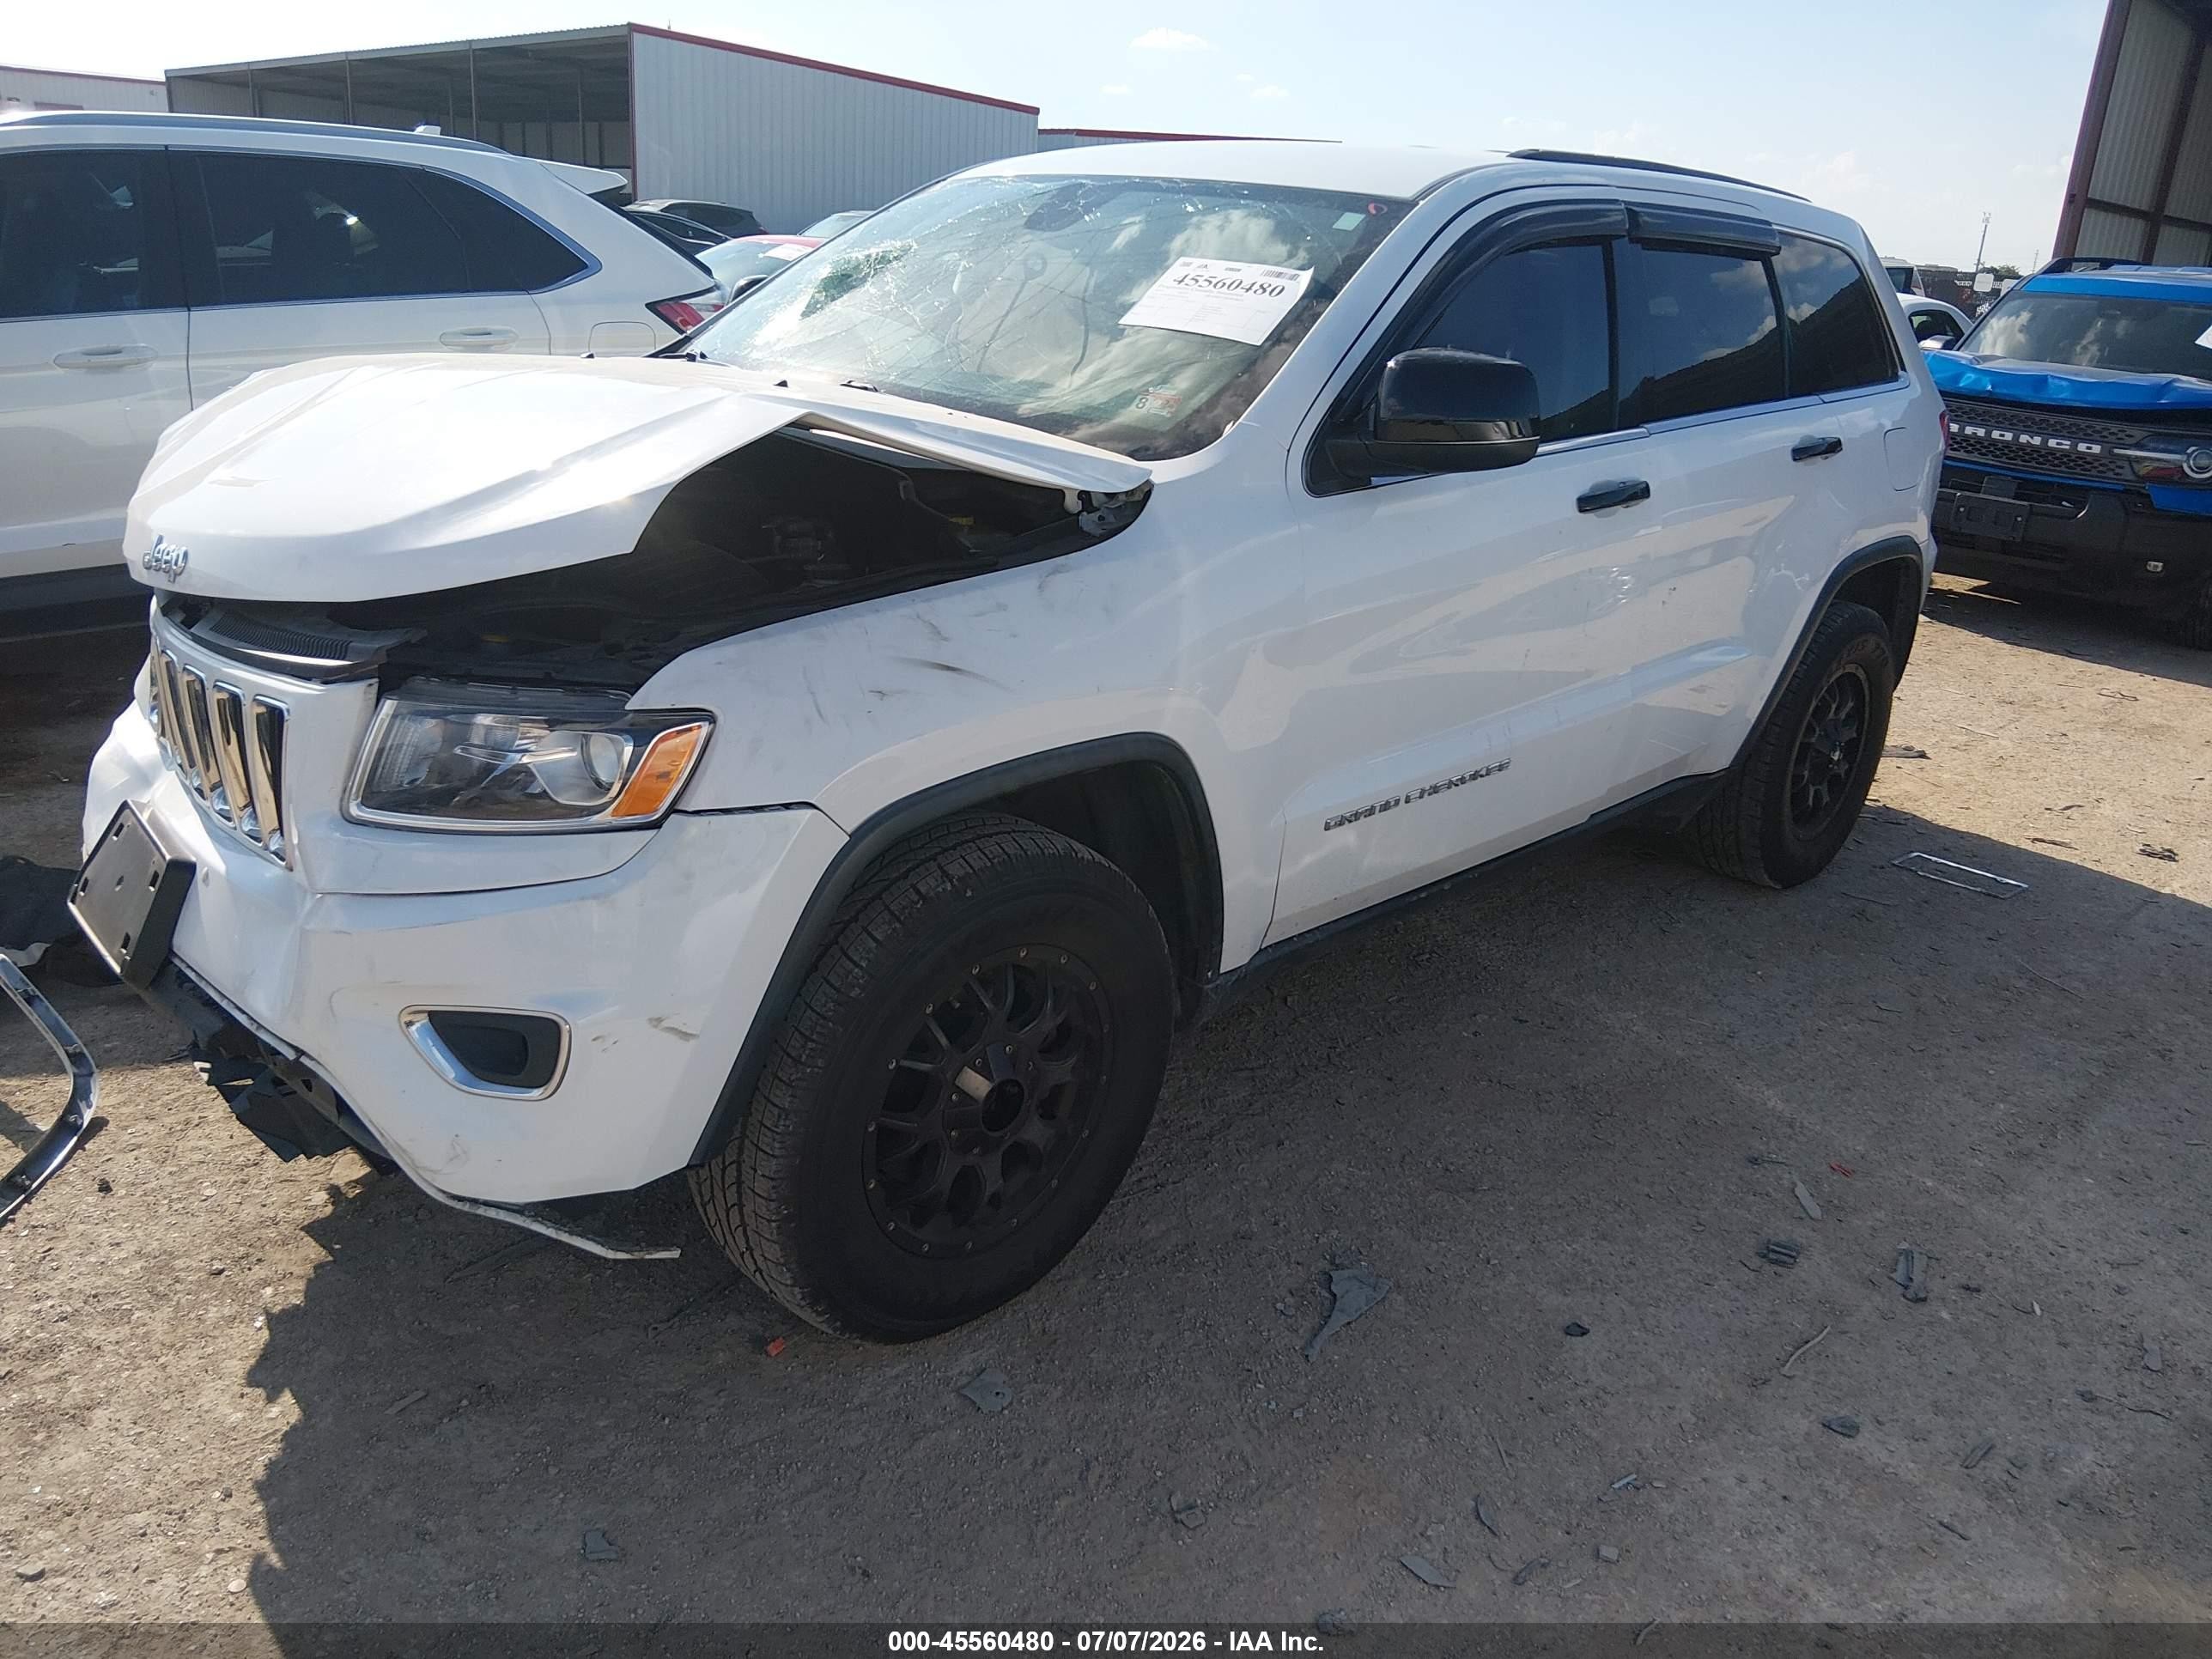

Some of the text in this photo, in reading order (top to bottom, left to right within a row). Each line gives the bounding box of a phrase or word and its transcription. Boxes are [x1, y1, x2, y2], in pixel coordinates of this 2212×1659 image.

[1172, 272, 1286, 298] 45560480
[143, 534, 189, 584] Jeep
[1323, 757, 1512, 831] GRAND CHEROKEE
